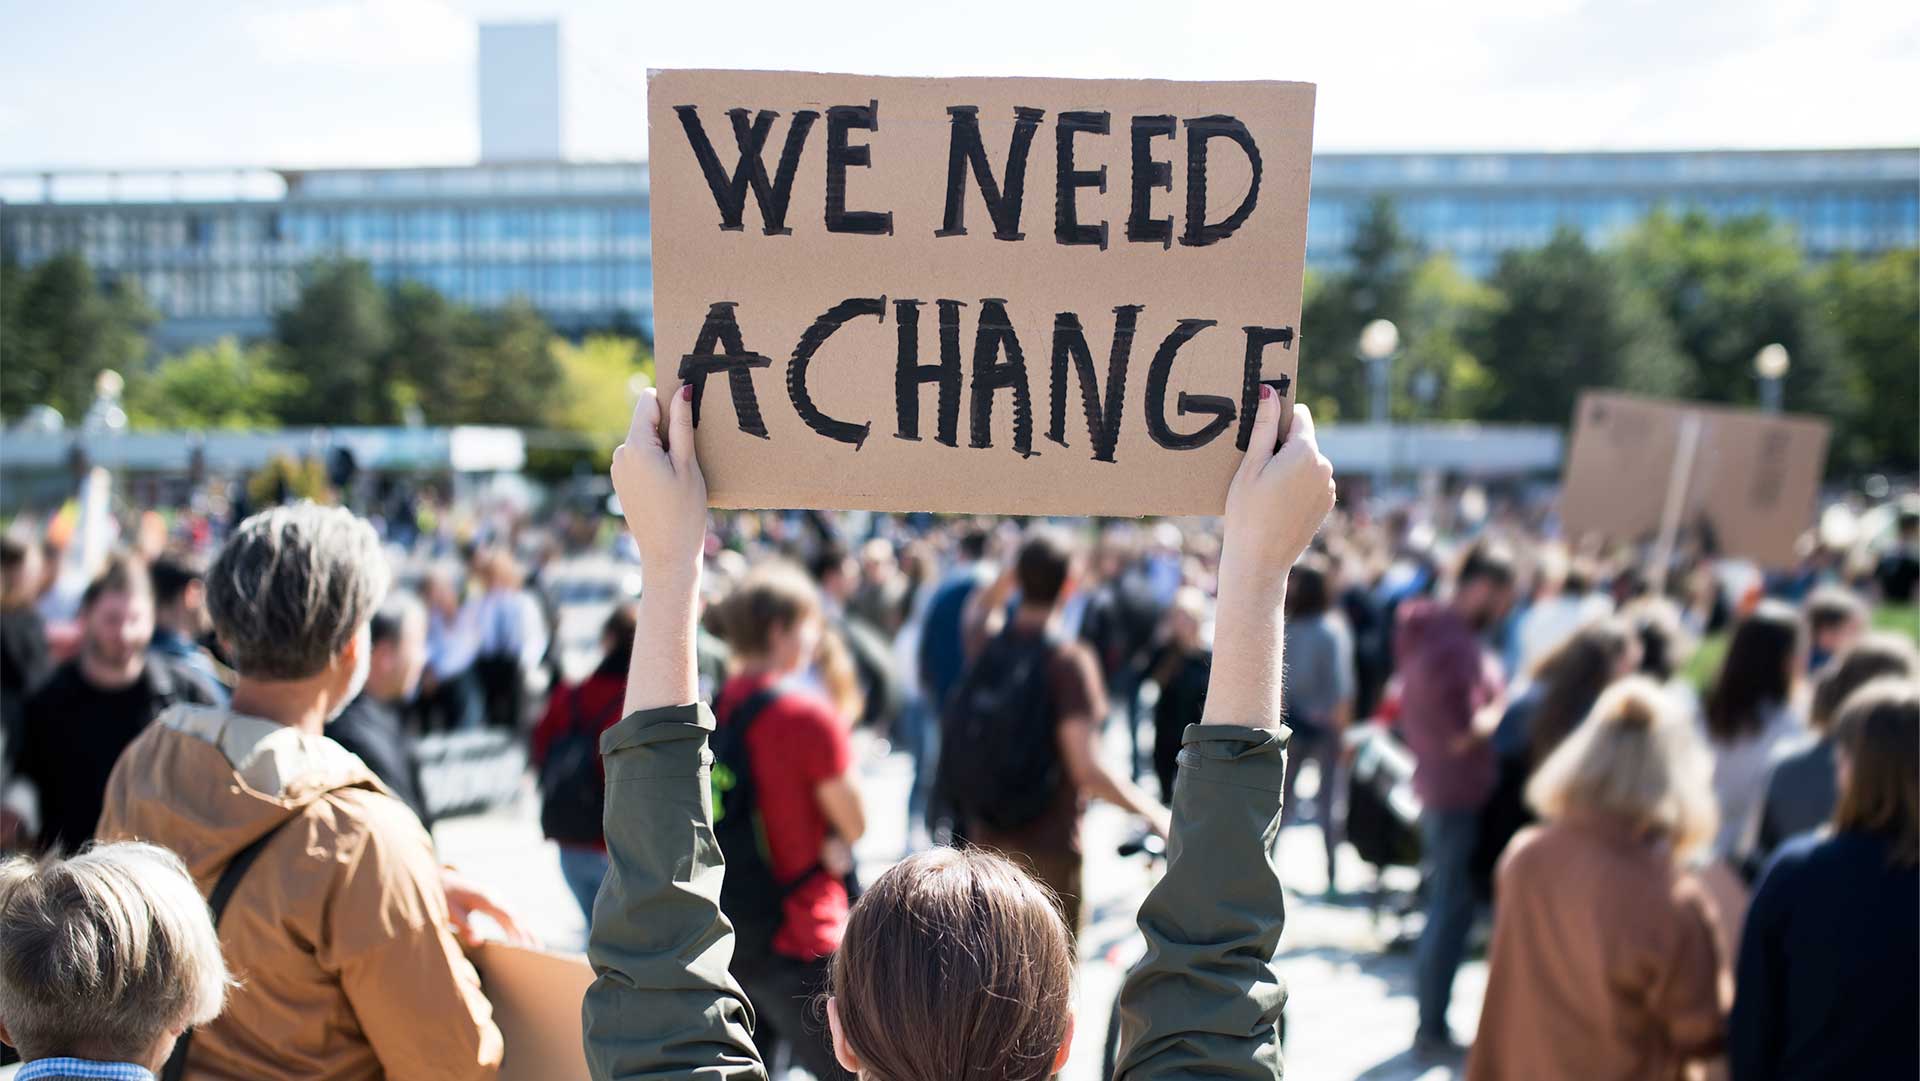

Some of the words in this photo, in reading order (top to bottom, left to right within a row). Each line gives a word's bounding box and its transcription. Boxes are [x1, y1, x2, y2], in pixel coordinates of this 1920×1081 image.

[673, 99, 893, 236] WE
[934, 106, 1263, 250] NEED
[678, 301, 772, 439] A
